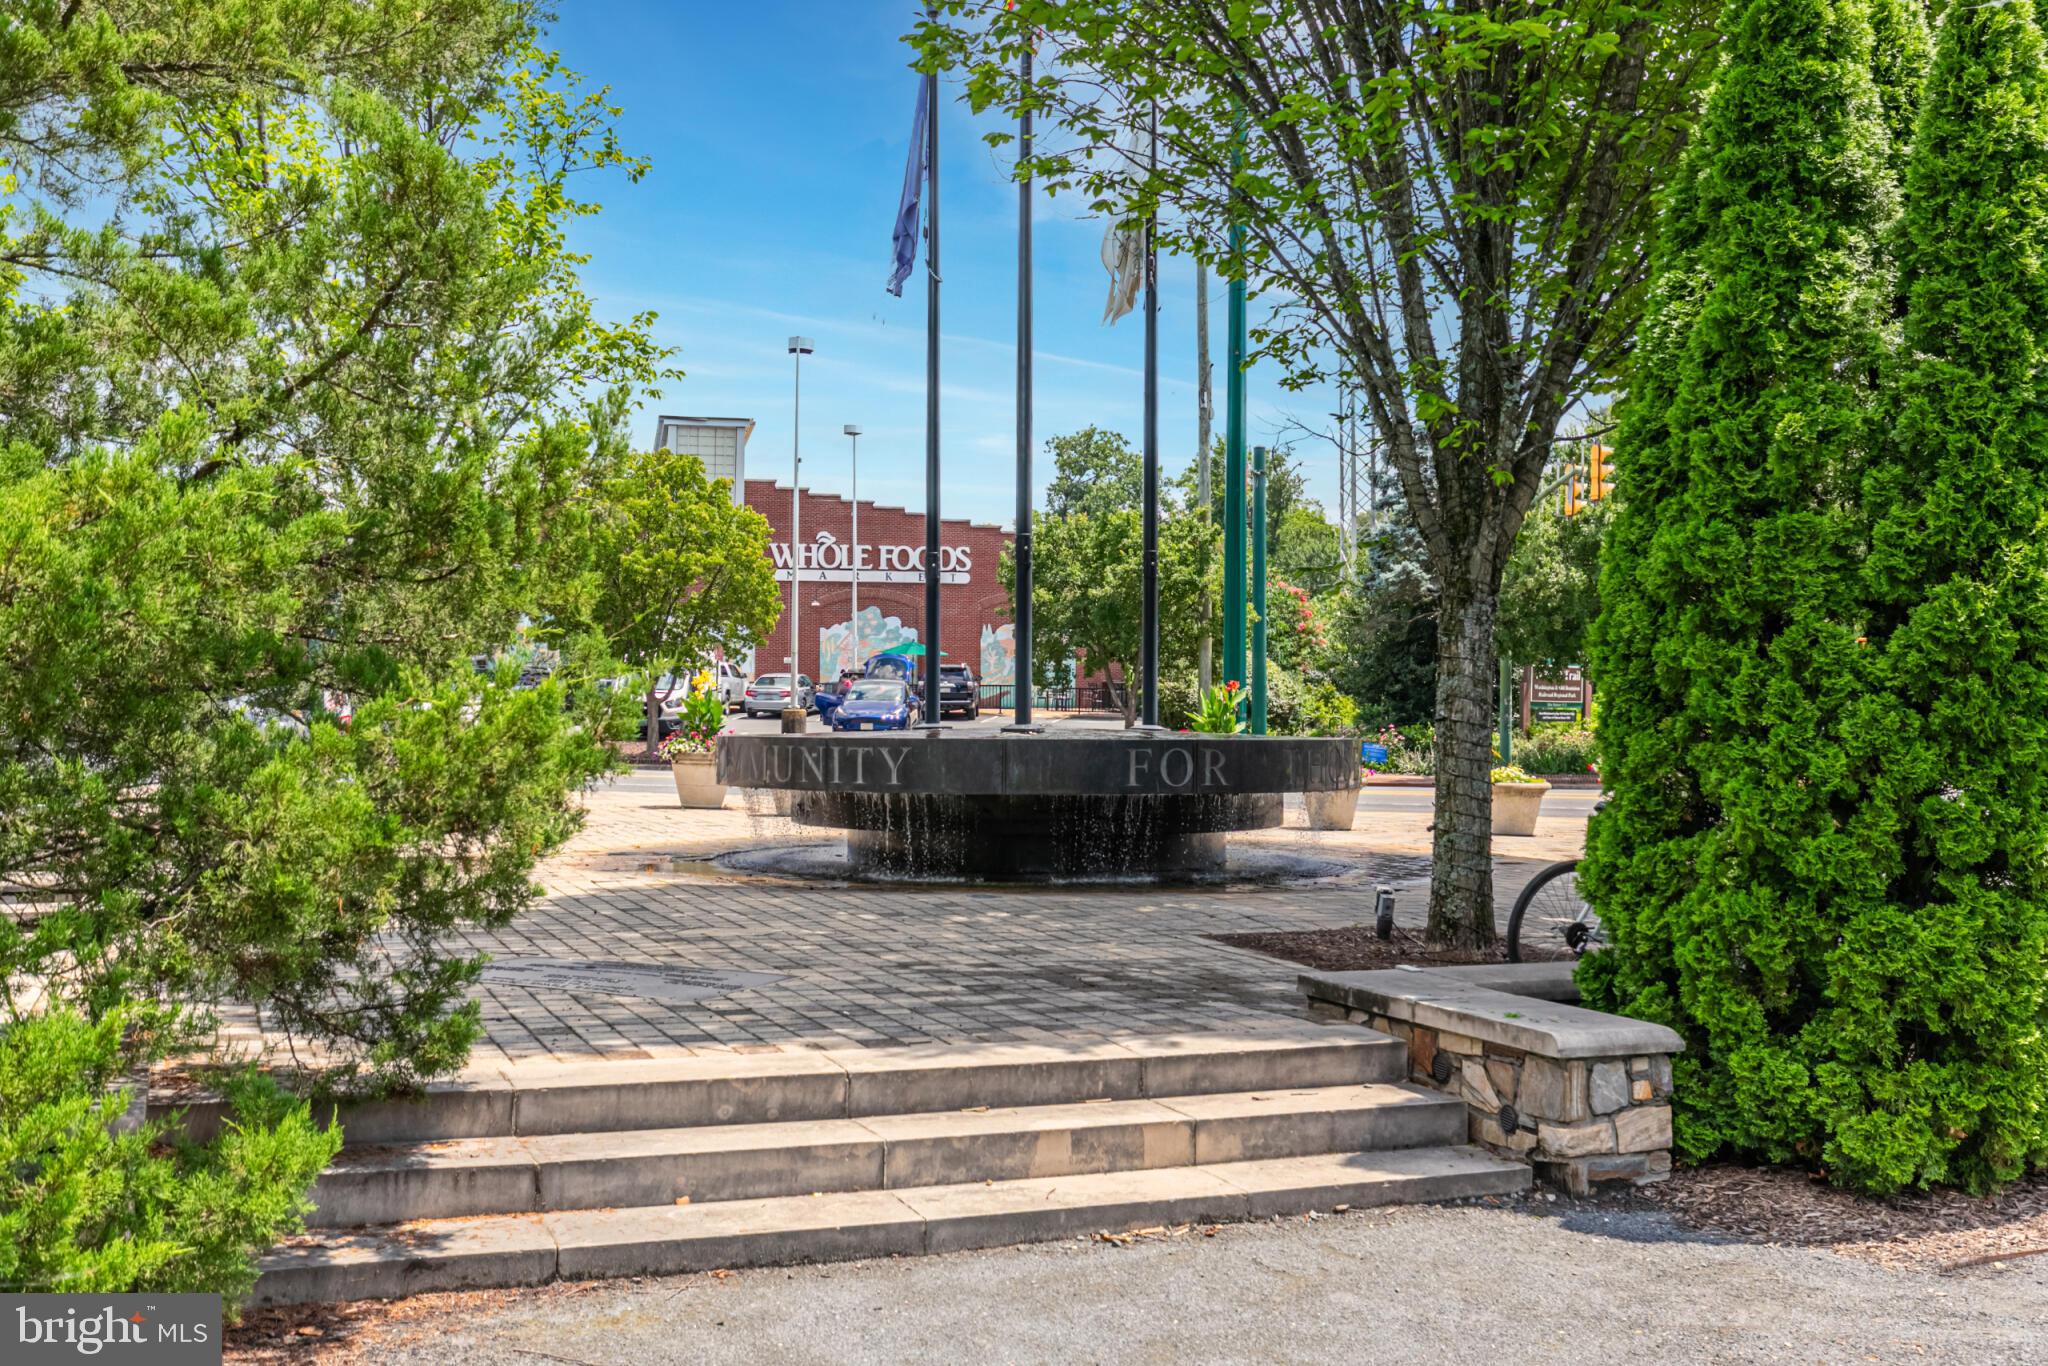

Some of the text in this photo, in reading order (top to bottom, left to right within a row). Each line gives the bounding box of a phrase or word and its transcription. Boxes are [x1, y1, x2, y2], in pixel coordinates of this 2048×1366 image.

[769, 531, 972, 572] WHOLE FOODS
[1124, 747, 1229, 787] FOR
